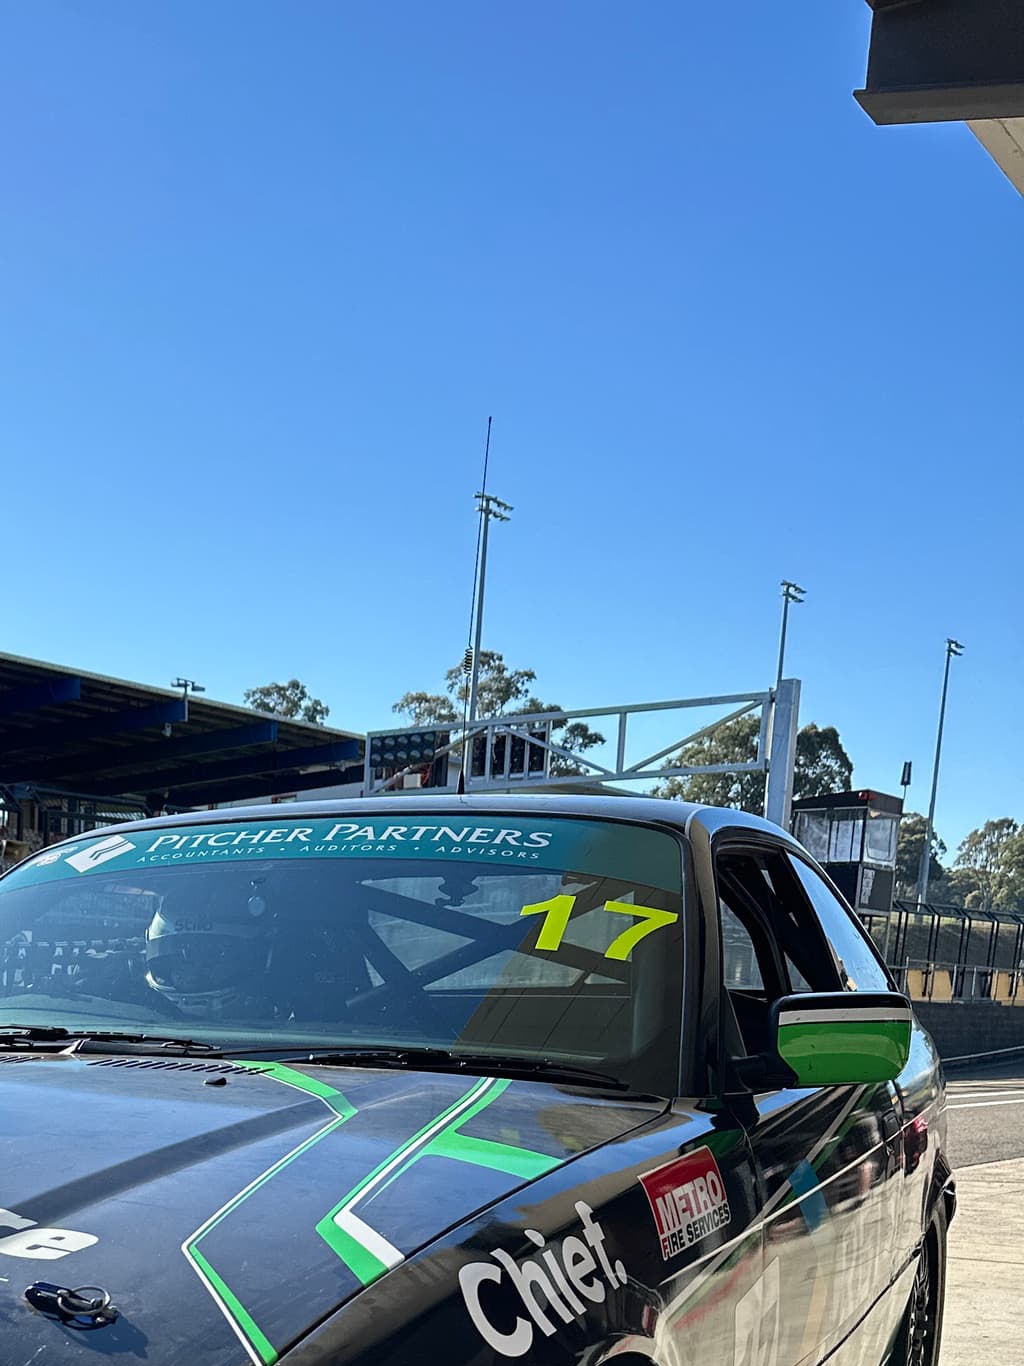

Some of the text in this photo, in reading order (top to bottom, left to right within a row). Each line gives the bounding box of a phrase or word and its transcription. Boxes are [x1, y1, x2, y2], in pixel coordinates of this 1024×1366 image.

[136, 844, 540, 863] ACCOUNTANTS AUDITORS ADVISORS
[145, 823, 553, 853] PITCHER PARTNERS
[519, 894, 679, 961] 17
[655, 1170, 723, 1233] METRO
[661, 1202, 730, 1260] FIRE SERVICES
